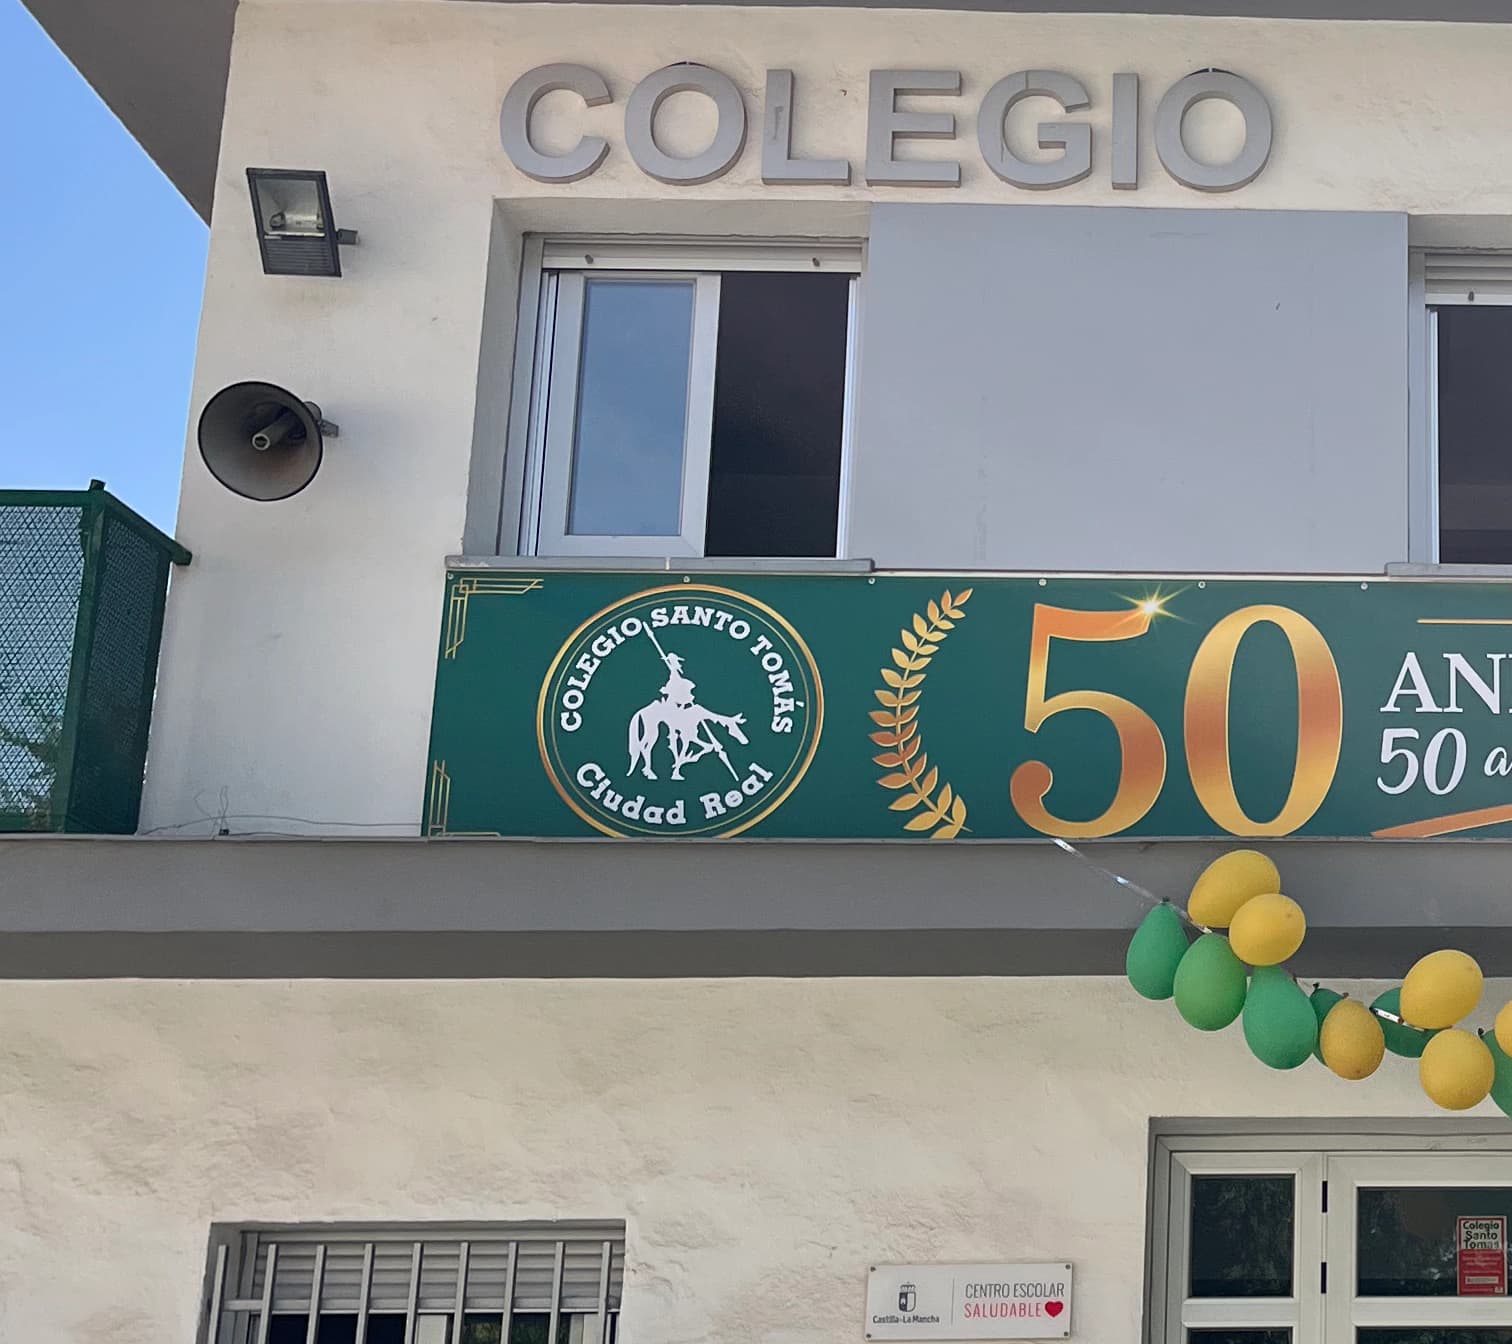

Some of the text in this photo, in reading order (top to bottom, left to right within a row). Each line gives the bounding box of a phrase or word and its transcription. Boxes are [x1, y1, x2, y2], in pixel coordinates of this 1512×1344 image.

[499, 61, 1275, 193] COLEGIO
[560, 606, 805, 734] COLEGIO SANTO TOMÁS
[1010, 603, 1343, 839] 50
[1376, 727, 1468, 796] 50
[576, 762, 774, 825] Ciudad Real
[1463, 1220, 1499, 1231] Colegio
[1466, 1230, 1497, 1240] Santo
[964, 1302, 1041, 1318] SALUDABLE
[965, 1282, 1065, 1299] CENTRO ESCOLAR
[912, 1315, 940, 1323] Mancha
